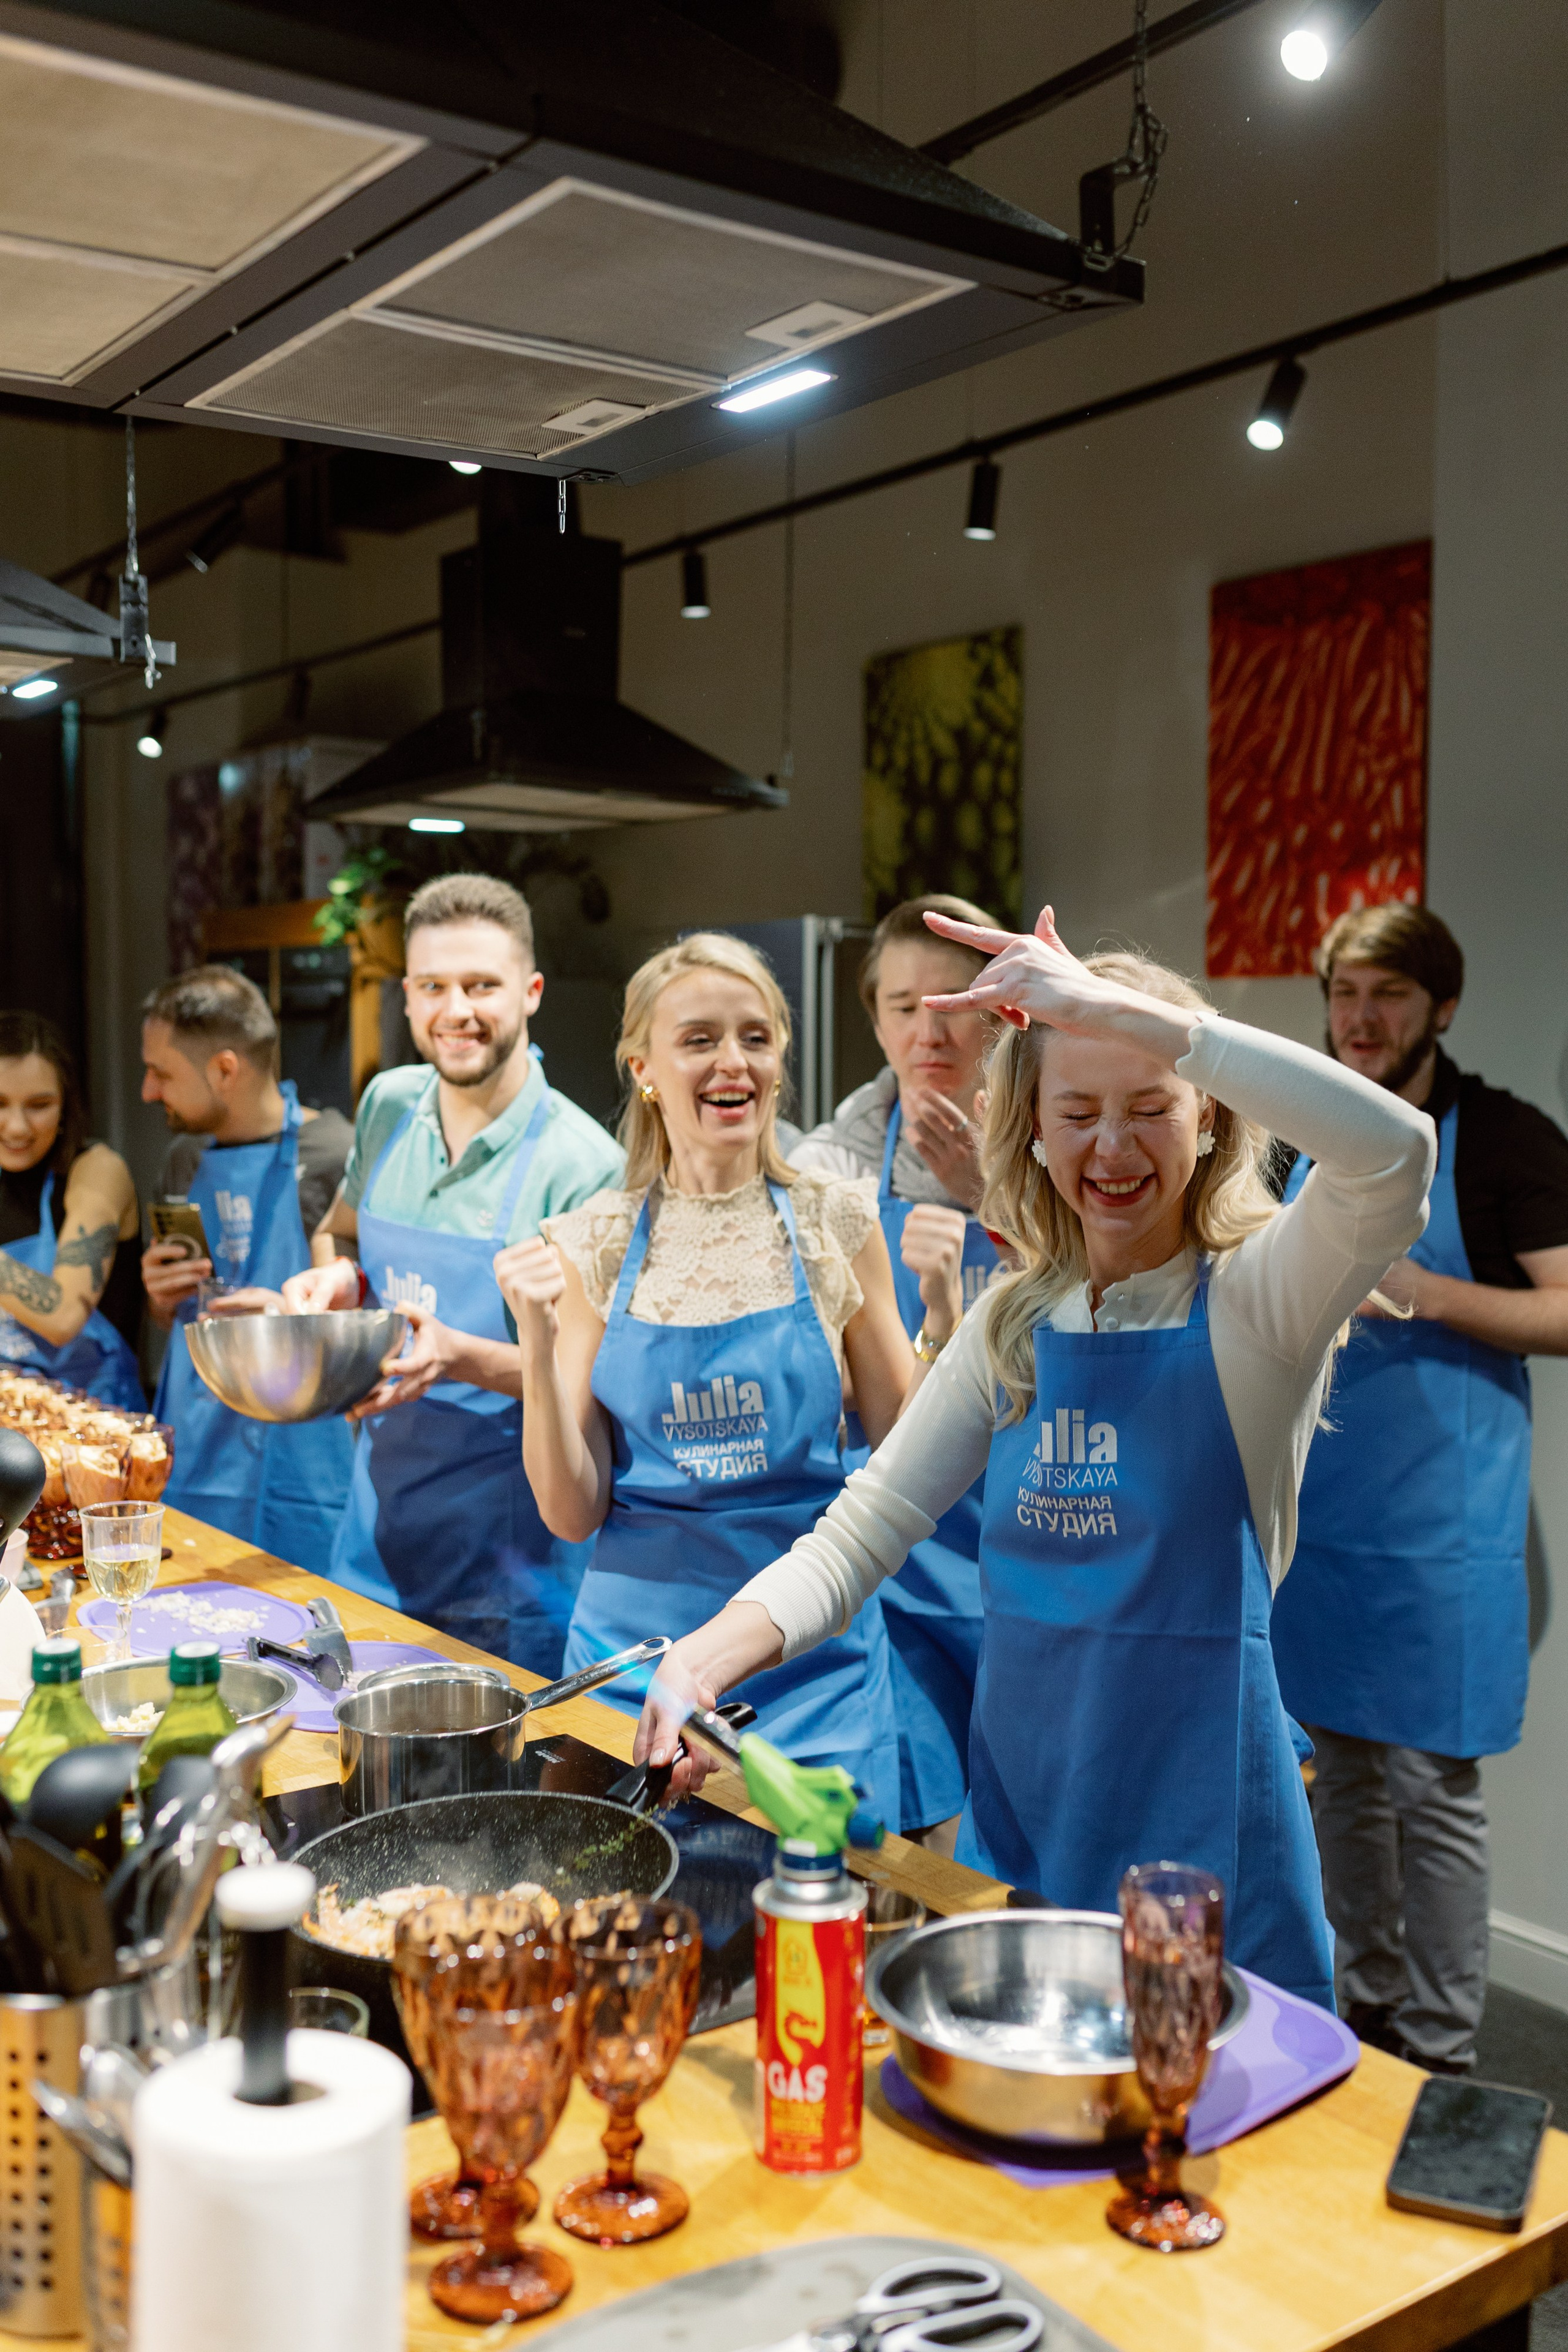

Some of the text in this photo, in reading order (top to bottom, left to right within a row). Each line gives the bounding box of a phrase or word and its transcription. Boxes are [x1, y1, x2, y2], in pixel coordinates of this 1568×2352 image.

[662, 1375, 764, 1424] Julia
[662, 1415, 769, 1442] VYSOTSKAYA
[673, 1439, 764, 1459] КУЛИНАРНАЯ
[1017, 1486, 1112, 1510] КУЛИНАРНАЯ
[1017, 1504, 1118, 1539] СТУДИЯ
[767, 2060, 828, 2103] GAS
